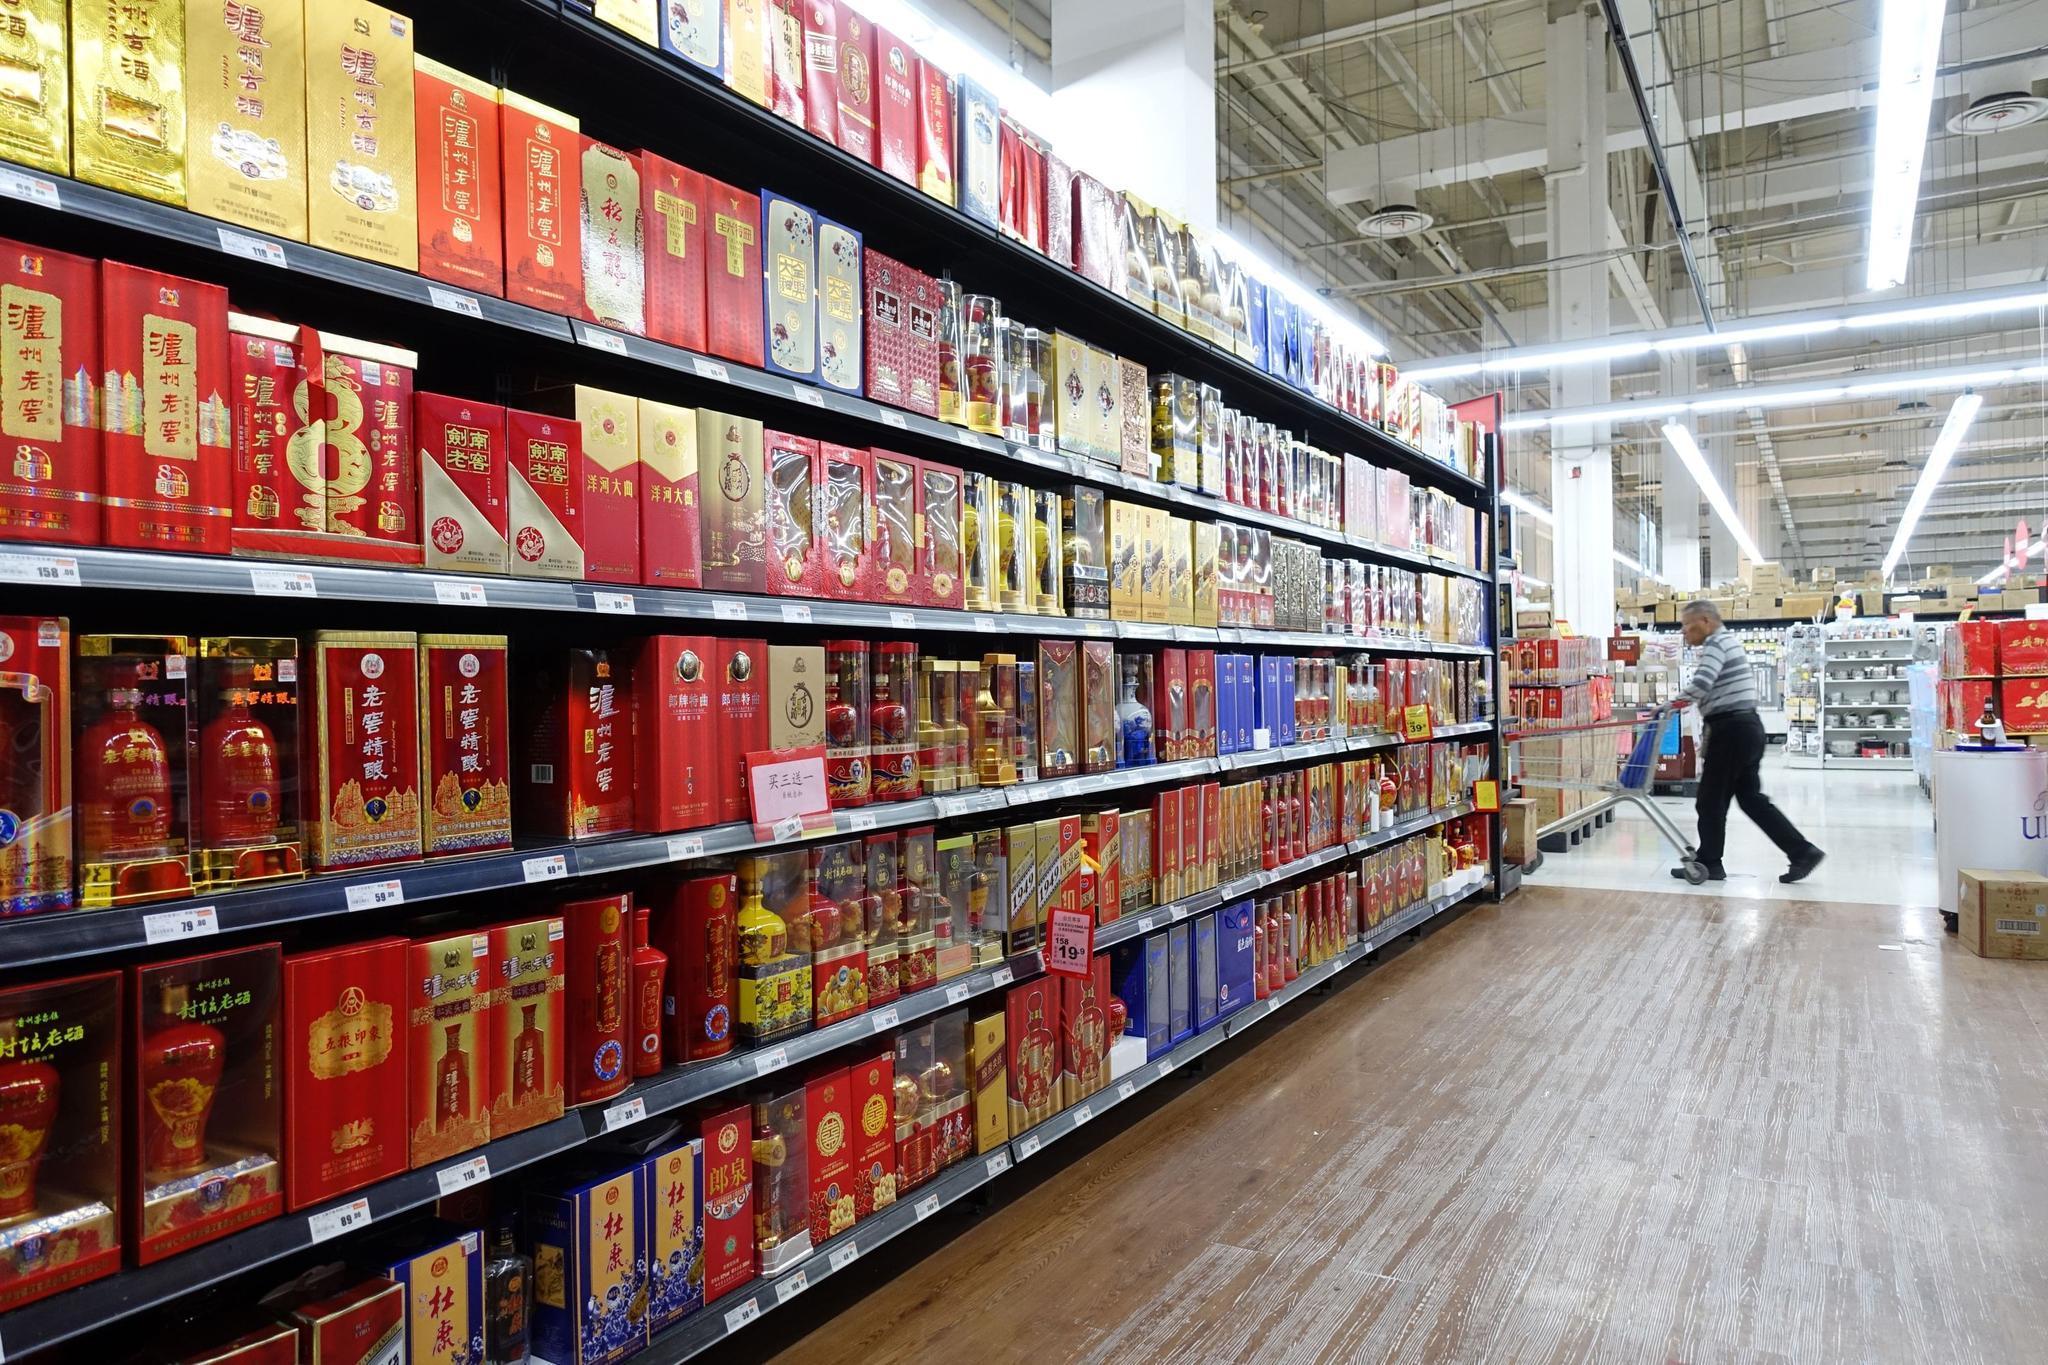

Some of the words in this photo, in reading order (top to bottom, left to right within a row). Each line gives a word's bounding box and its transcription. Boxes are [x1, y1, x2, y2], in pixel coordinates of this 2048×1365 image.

[8, 303, 54, 424] 瀘州老窖
[149, 331, 192, 444] 瀘州老窖
[244, 373, 282, 475] 瀘州老窖
[374, 400, 404, 493] 瀘州老窖
[587, 474, 634, 499] 洋河大曲
[651, 485, 694, 507] 洋河大曲
[37, 566, 59, 578] 158
[361, 684, 388, 782] 老窖精酿
[459, 682, 483, 773] 老窖精酿
[589, 684, 620, 792] 瀘州老窖
[687, 782, 693, 795] 3
[768, 771, 814, 790] 买三送一
[375, 892, 386, 903] 59
[1011, 871, 1034, 910] 1949
[1039, 865, 1060, 901] 1949
[181, 920, 194, 933] 79
[1055, 937, 1069, 946] 158
[1058, 945, 1085, 960] 19.9
[710, 1157, 748, 1197] 郎泉
[341, 1214, 352, 1227] 89
[668, 1181, 685, 1240] 杜康
[604, 1212, 624, 1275] 杜康
[428, 1285, 455, 1357] 杜康
